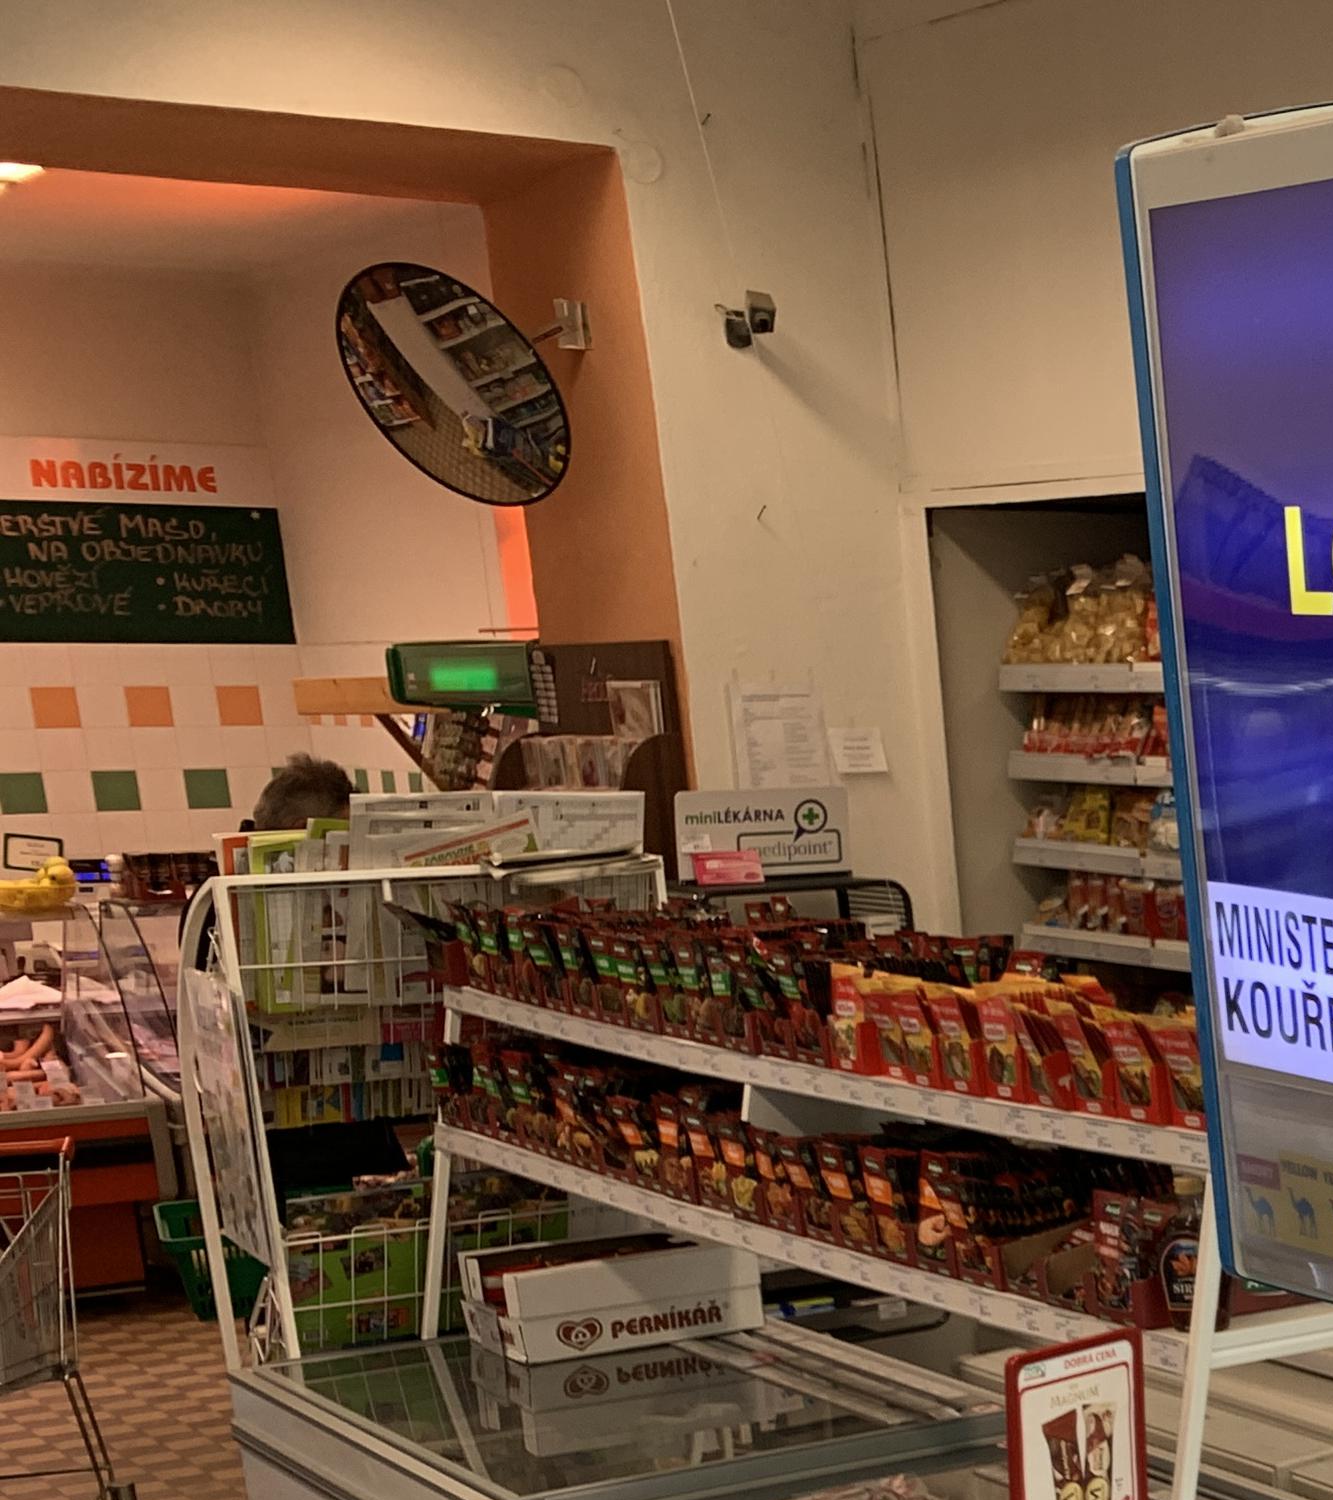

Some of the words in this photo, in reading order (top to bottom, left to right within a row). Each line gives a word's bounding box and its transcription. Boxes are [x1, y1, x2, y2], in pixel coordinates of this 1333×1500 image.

[30, 453, 218, 493] NABÍZÍME
[28, 541, 68, 562] NA
[609, 1304, 723, 1340] PERNÍKÁŘ
